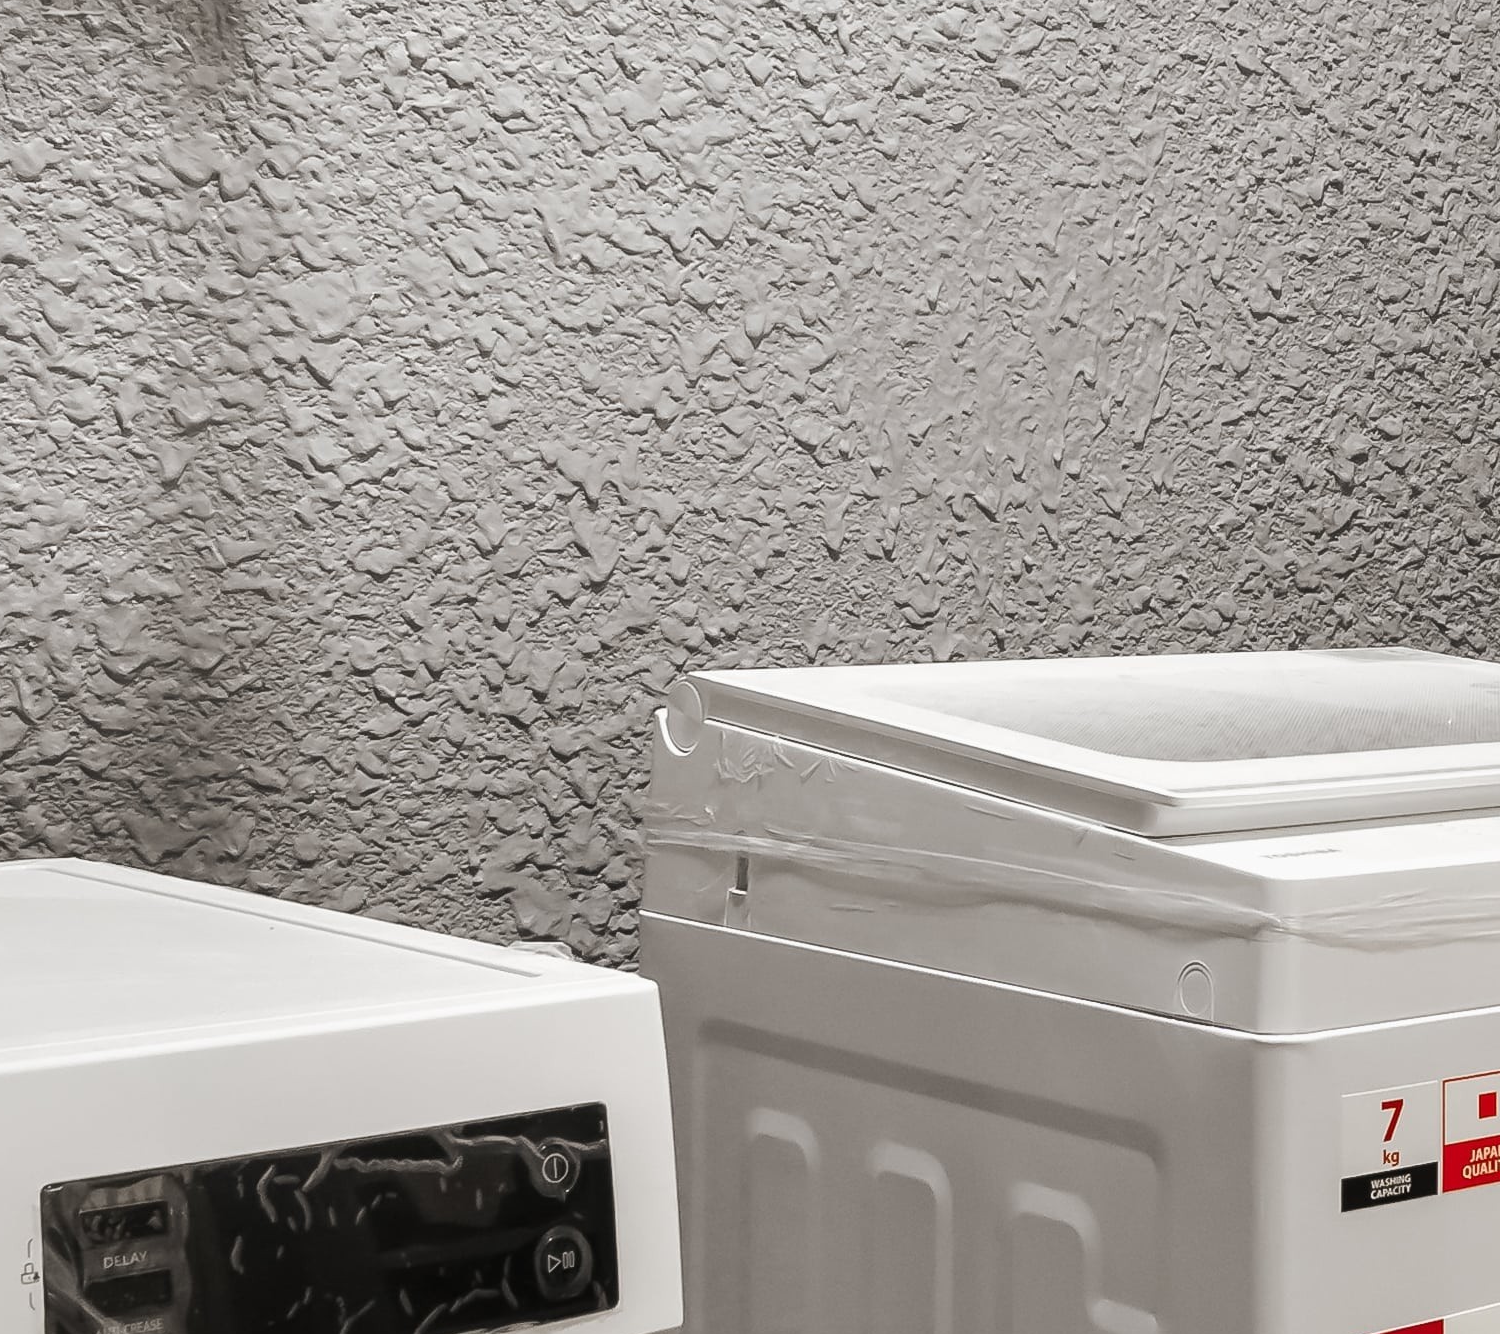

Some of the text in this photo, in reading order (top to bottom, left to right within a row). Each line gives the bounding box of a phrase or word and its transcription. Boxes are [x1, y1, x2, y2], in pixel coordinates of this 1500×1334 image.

[1381, 1099, 1403, 1142] 7
[1383, 1150, 1400, 1166] kg
[1371, 1174, 1411, 1190] WASHING
[1370, 1183, 1411, 1200] CAPACITY
[103, 1251, 148, 1269] DELAY
